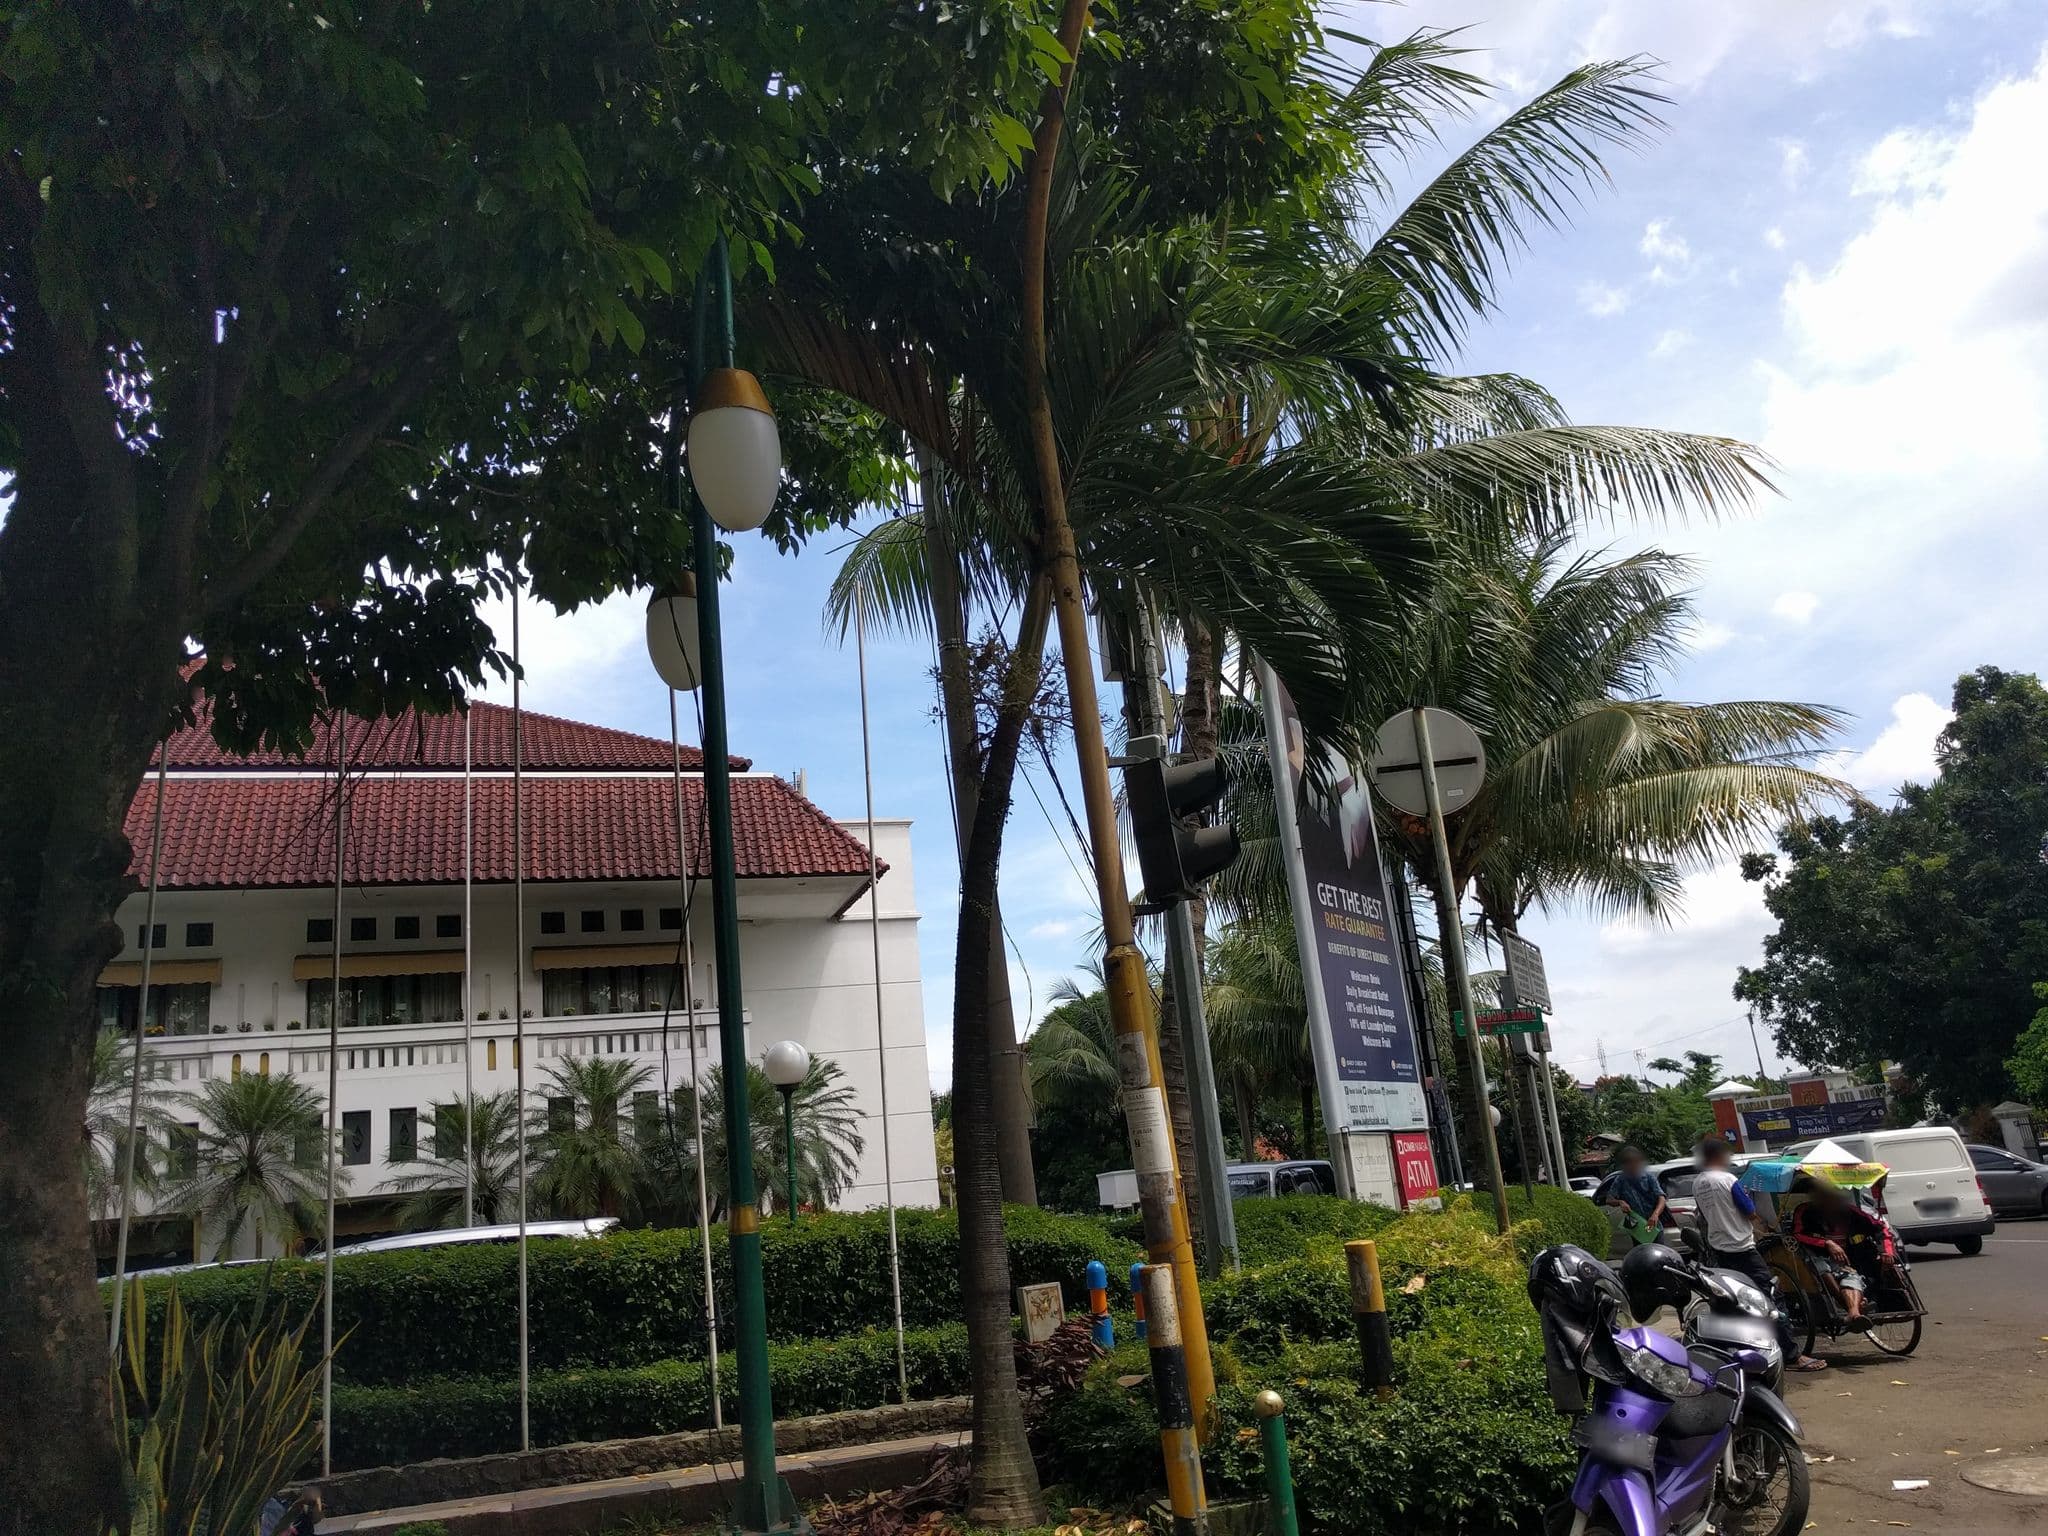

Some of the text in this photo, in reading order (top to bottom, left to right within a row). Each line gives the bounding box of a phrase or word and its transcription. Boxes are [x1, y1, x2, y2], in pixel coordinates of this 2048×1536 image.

[1317, 882, 1383, 921] GET THE BEST
[1325, 911, 1386, 942] RATE GUARANTEE
[1350, 946, 1356, 958] OF
[1351, 970, 1370, 984] Welcome
[1346, 1001, 1356, 1013] 10%
[1362, 1003, 1374, 1015] Food
[1349, 1018, 1360, 1029] 10%
[1359, 1020, 1367, 1030] off
[1366, 1020, 1383, 1033] Laundry
[1362, 1036, 1382, 1048] Welcome
[1798, 1125, 1830, 1136] Rendah!
[1407, 1160, 1432, 1189] ATM
